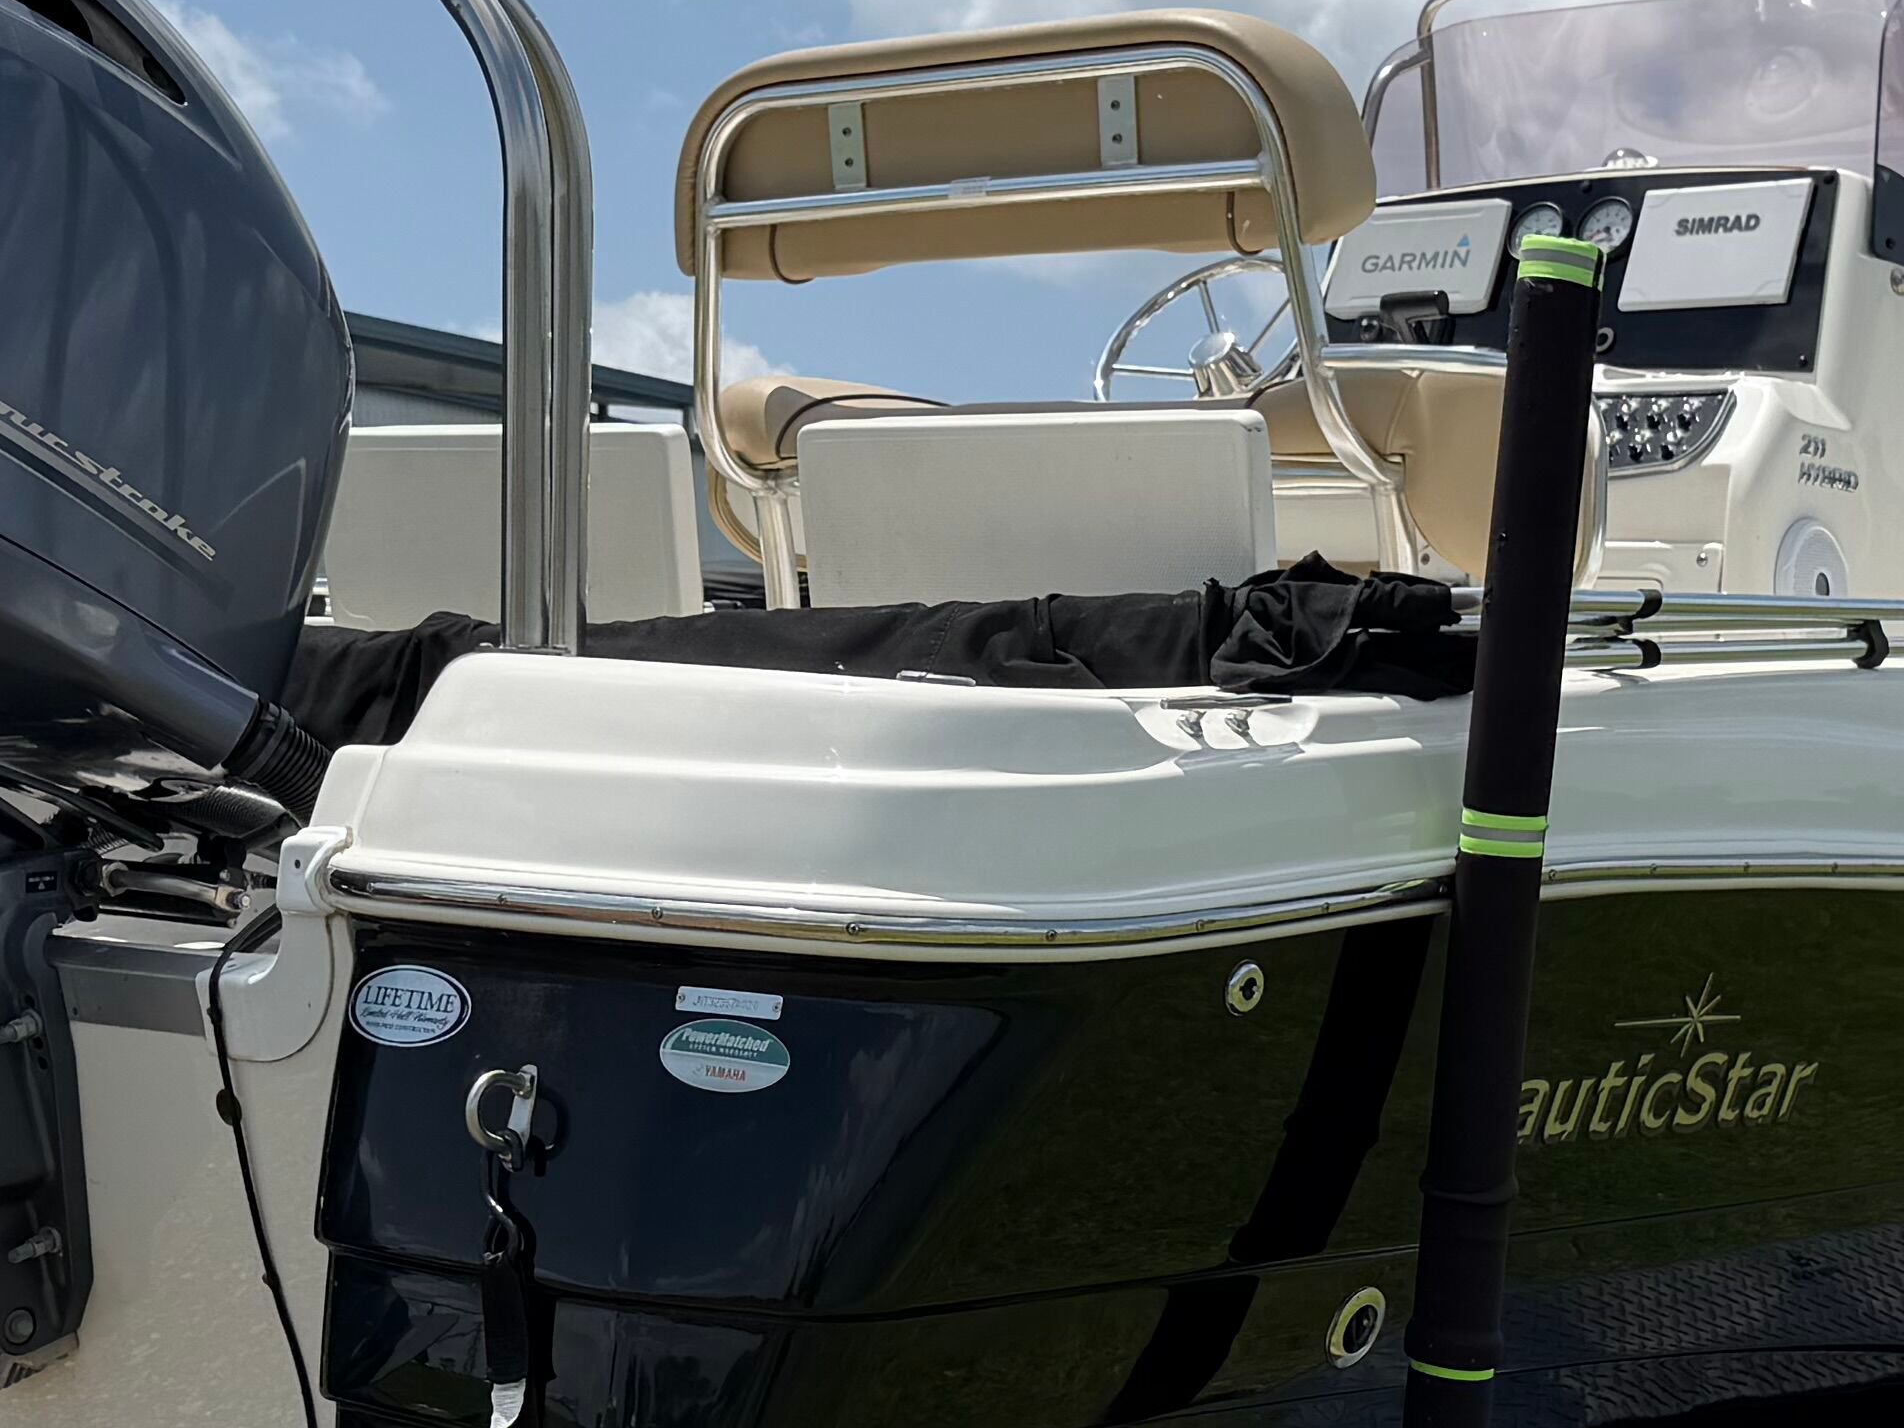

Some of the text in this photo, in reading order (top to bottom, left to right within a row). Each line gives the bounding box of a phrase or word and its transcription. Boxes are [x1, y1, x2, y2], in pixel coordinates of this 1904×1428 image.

[1674, 213, 1762, 238] SIMRAD
[1361, 248, 1471, 275] GARMIN
[362, 985, 458, 1014] LIFETIME
[681, 1028, 771, 1052] PowerMatched
[704, 1064, 747, 1081] YAMAHA
[1517, 1051, 1819, 1145] auticStar
